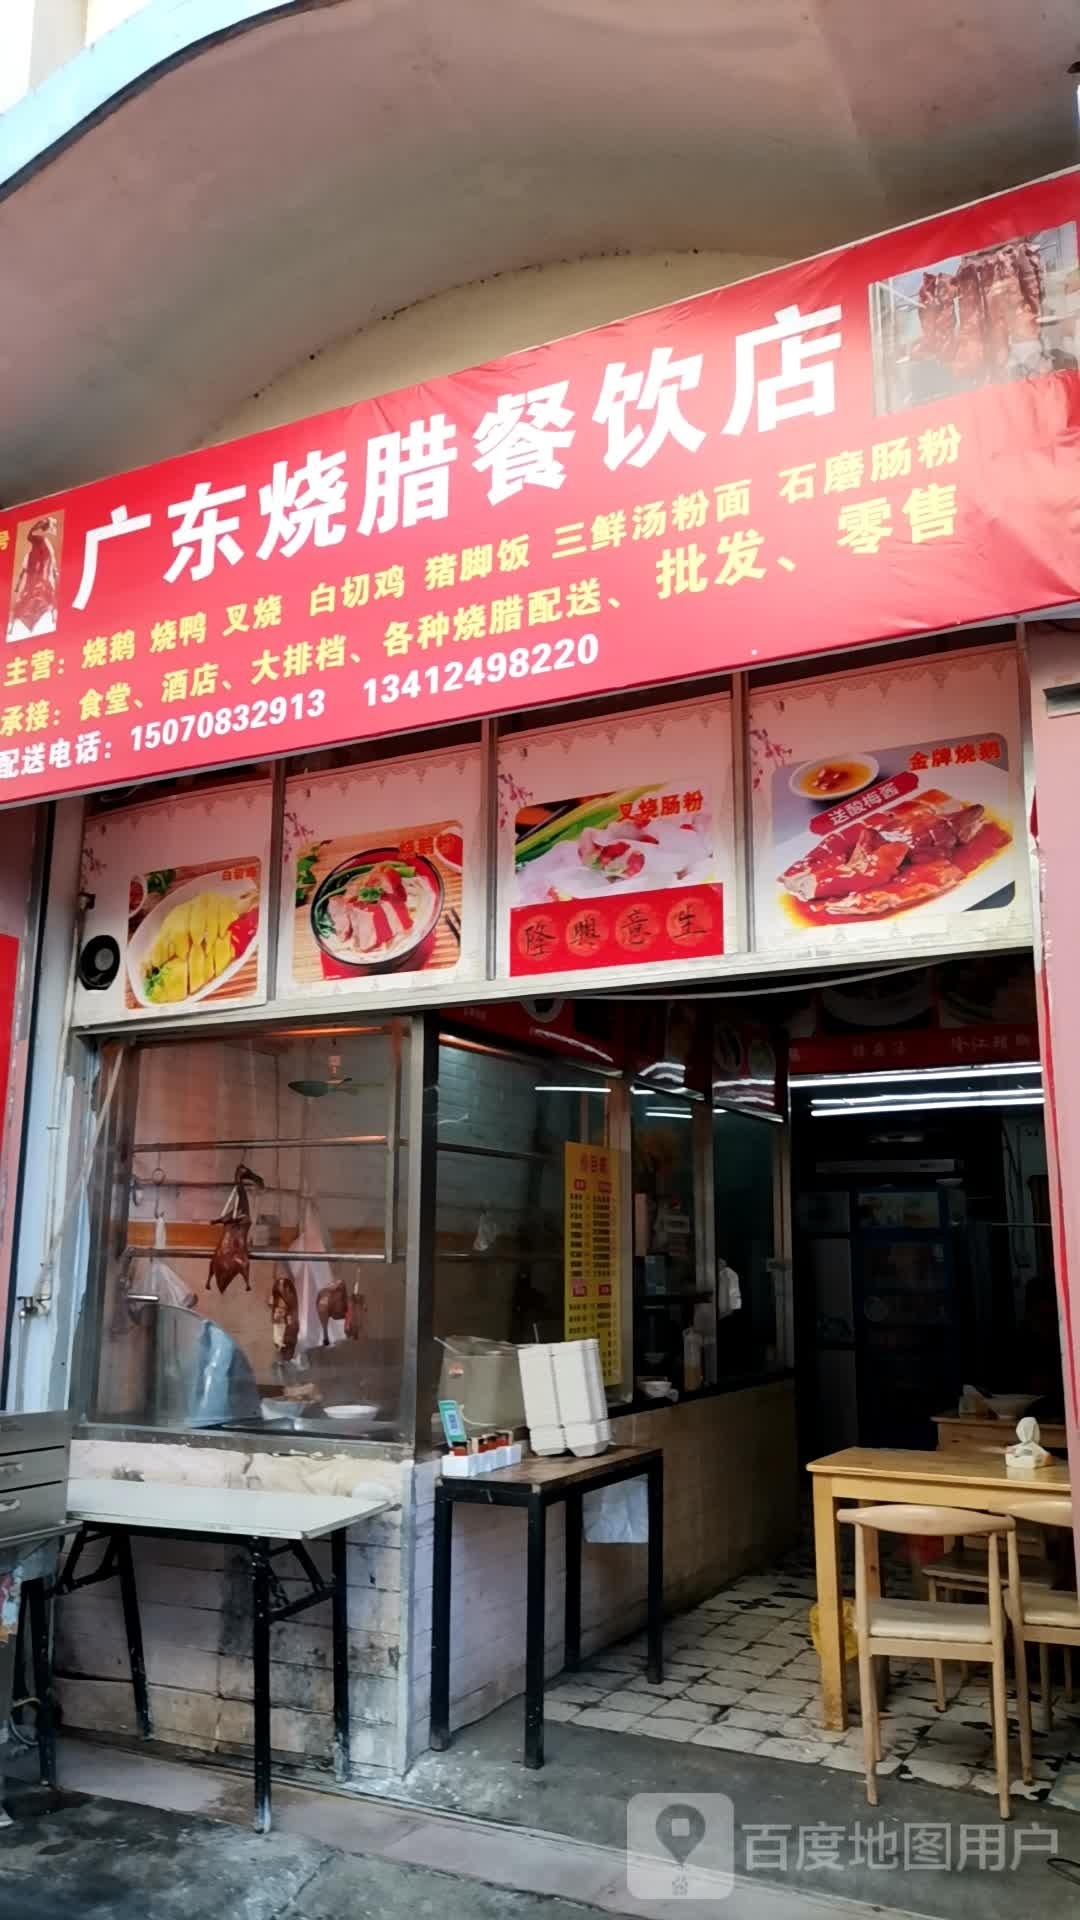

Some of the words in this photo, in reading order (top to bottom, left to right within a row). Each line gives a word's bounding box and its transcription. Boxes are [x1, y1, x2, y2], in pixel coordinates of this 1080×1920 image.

[72, 304, 844, 610] 广东烧腊餐饮店
[149, 612, 207, 653] 烧鸭
[222, 595, 282, 636] 叉烧
[309, 565, 405, 616] 白切鸡
[424, 534, 530, 591] 猪脚饭
[552, 480, 752, 559] 三鲜汤粉面
[779, 424, 961, 504] 石磨肠粉
[131, 689, 325, 751] 15070832913
[364, 633, 598, 707] 13412498220
[616, 790, 703, 824] 叉烧肠粉
